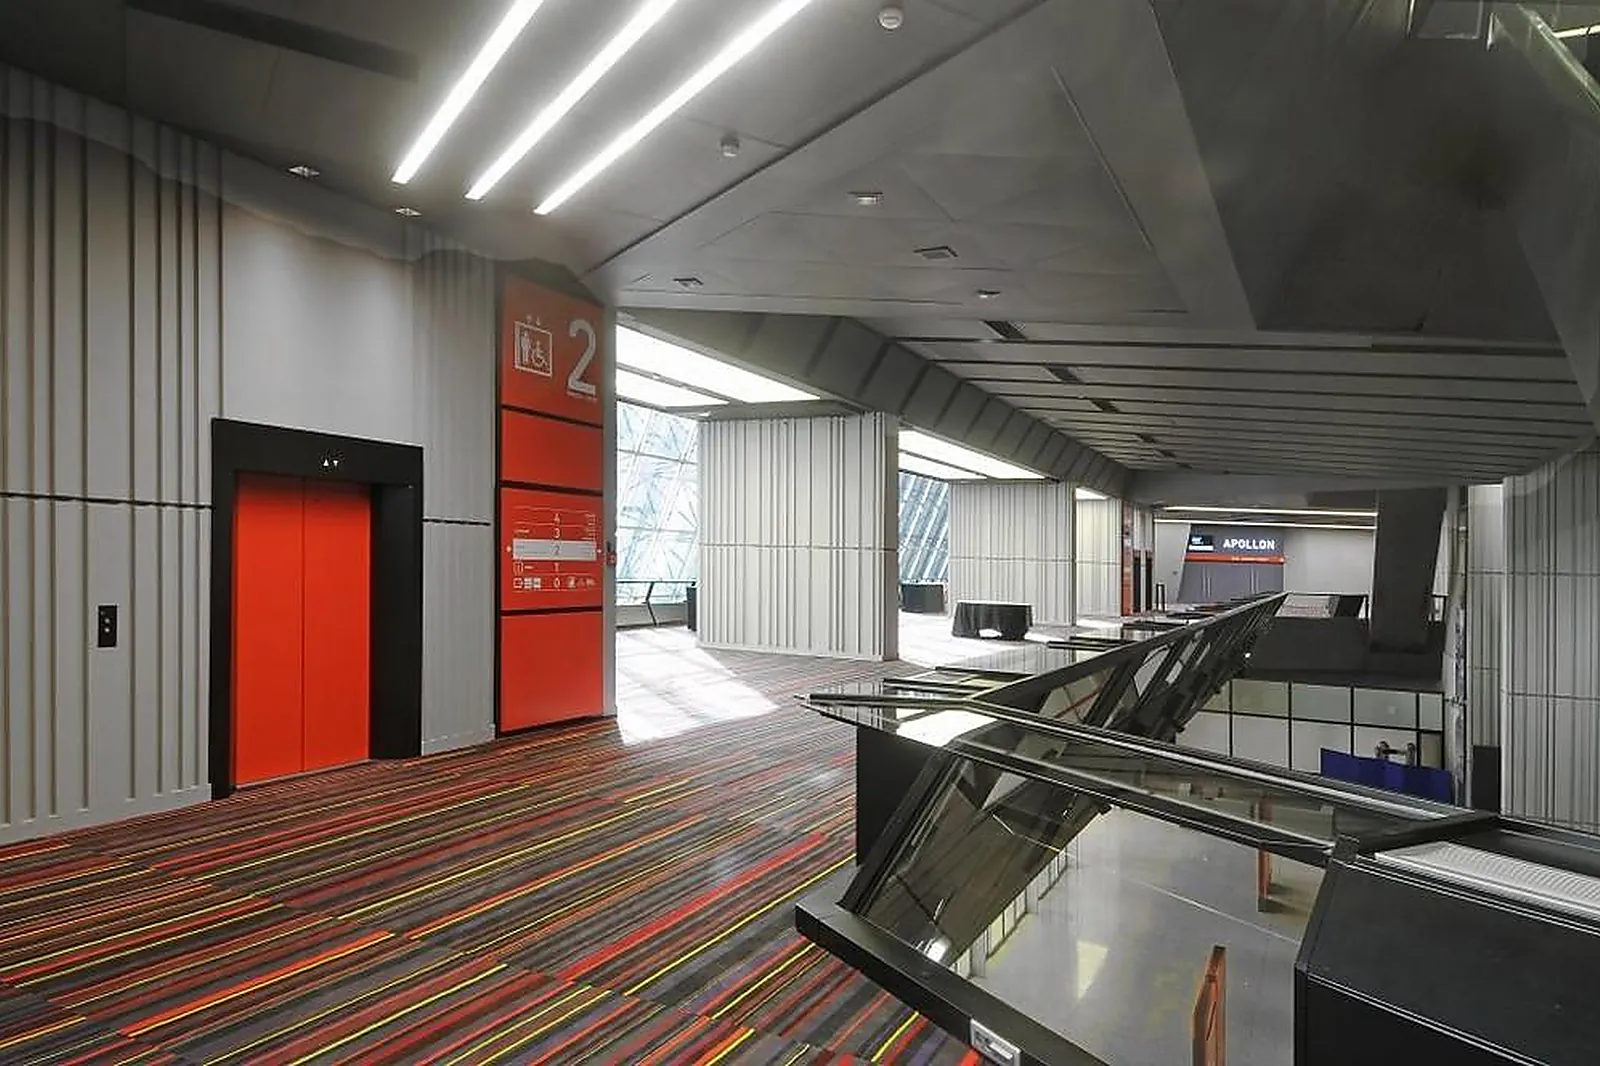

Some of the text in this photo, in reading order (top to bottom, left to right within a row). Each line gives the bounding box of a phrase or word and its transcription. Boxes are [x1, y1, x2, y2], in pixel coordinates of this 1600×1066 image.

[568, 319, 596, 395] 2
[553, 528, 560, 539] 3
[552, 543, 561, 556] 2
[1223, 539, 1275, 550] APOLLON
